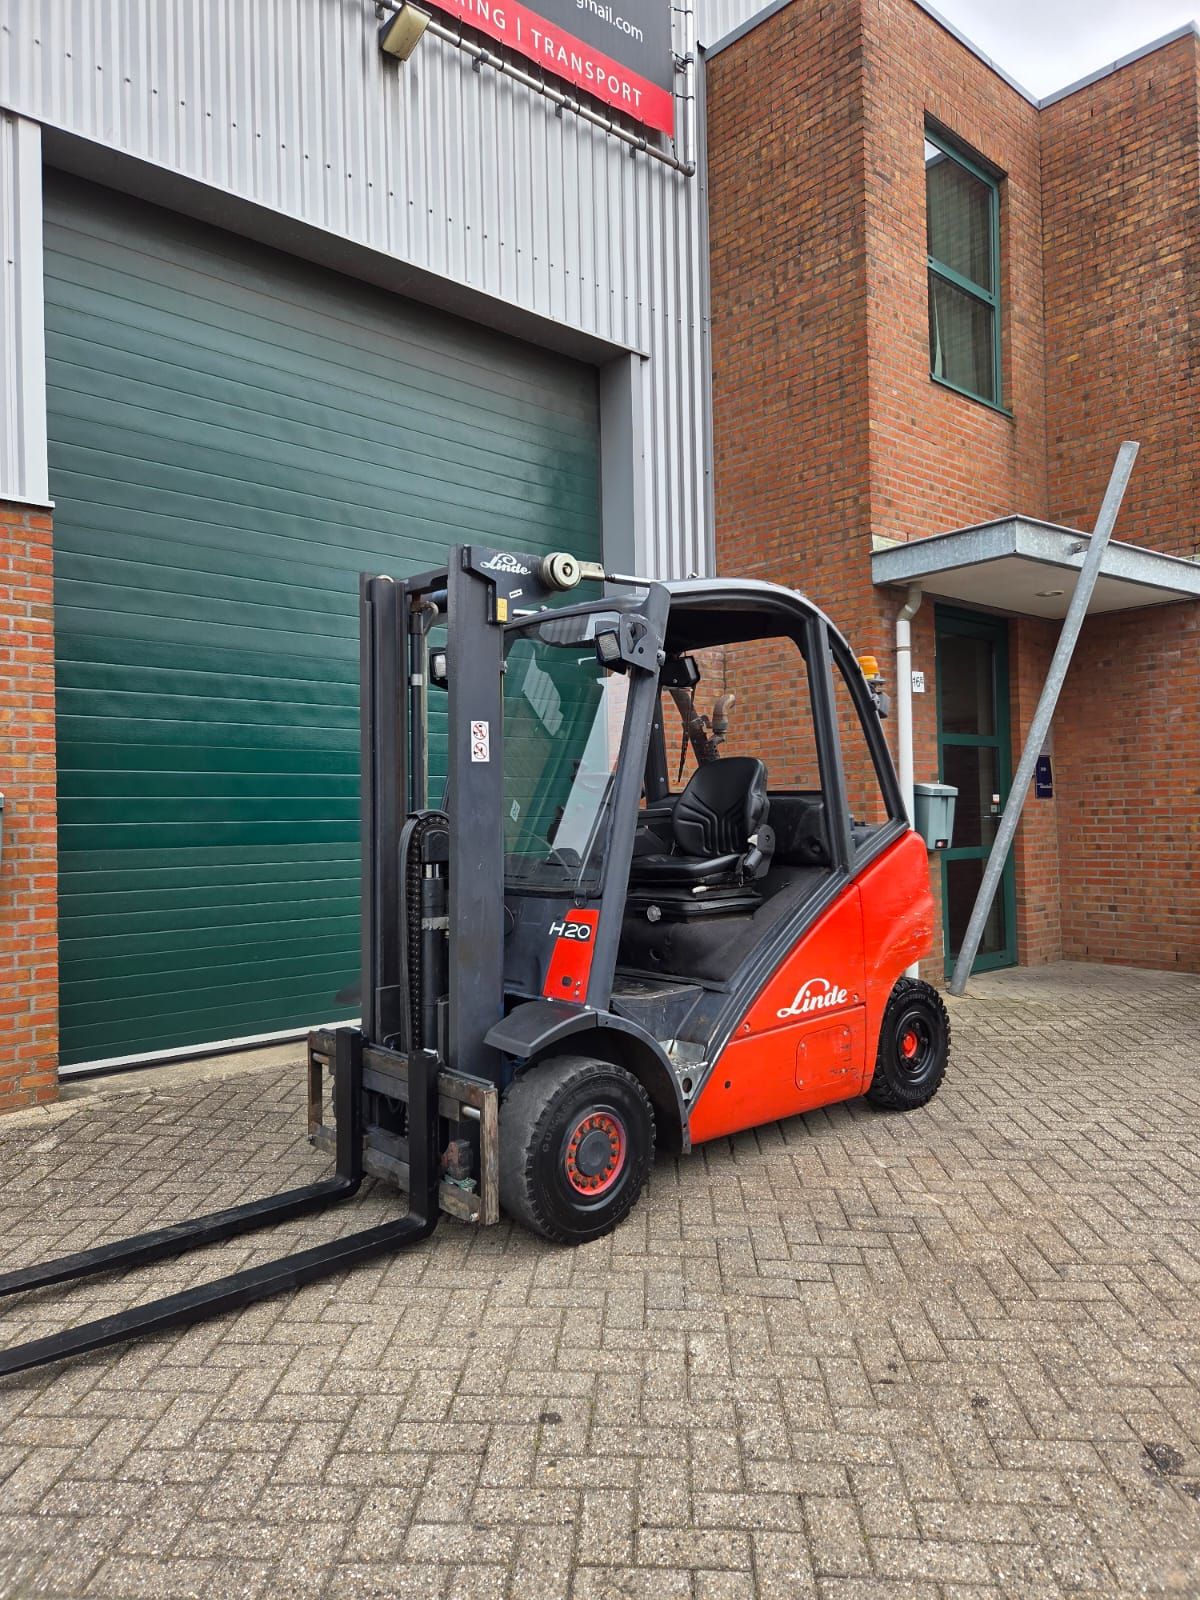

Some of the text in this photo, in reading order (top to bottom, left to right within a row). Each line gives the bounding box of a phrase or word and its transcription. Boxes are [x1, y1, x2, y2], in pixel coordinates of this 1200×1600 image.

[454, 0, 506, 31] ING
[530, 28, 642, 107] TRANSPORT
[479, 553, 532, 575] Linde
[548, 921, 591, 940] H20
[776, 977, 849, 1018] Linde
